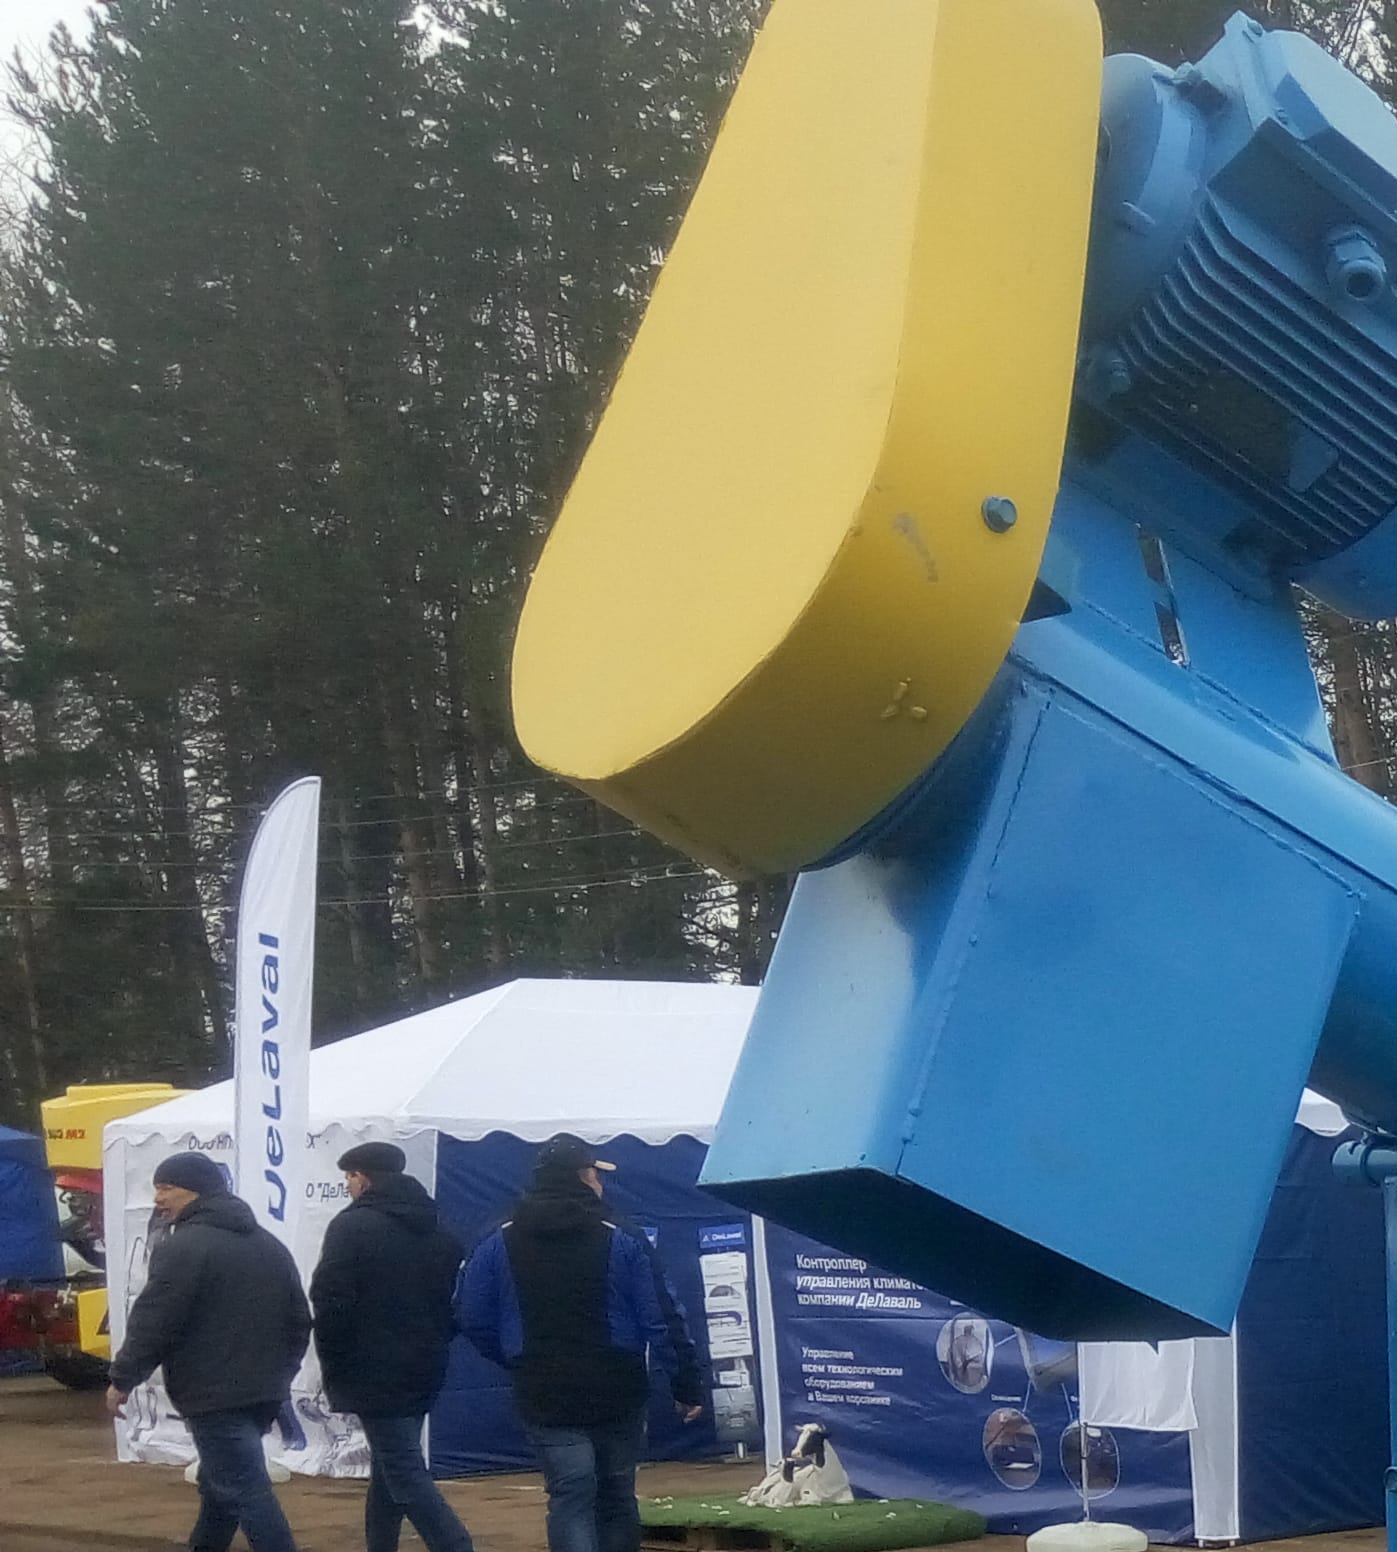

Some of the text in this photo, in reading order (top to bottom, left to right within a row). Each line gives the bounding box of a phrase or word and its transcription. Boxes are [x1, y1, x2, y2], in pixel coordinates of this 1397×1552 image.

[796, 1254, 867, 1274] Контроллер
[796, 1275, 870, 1290] управления
[797, 1292, 922, 1309] компании ДеЛаваль
